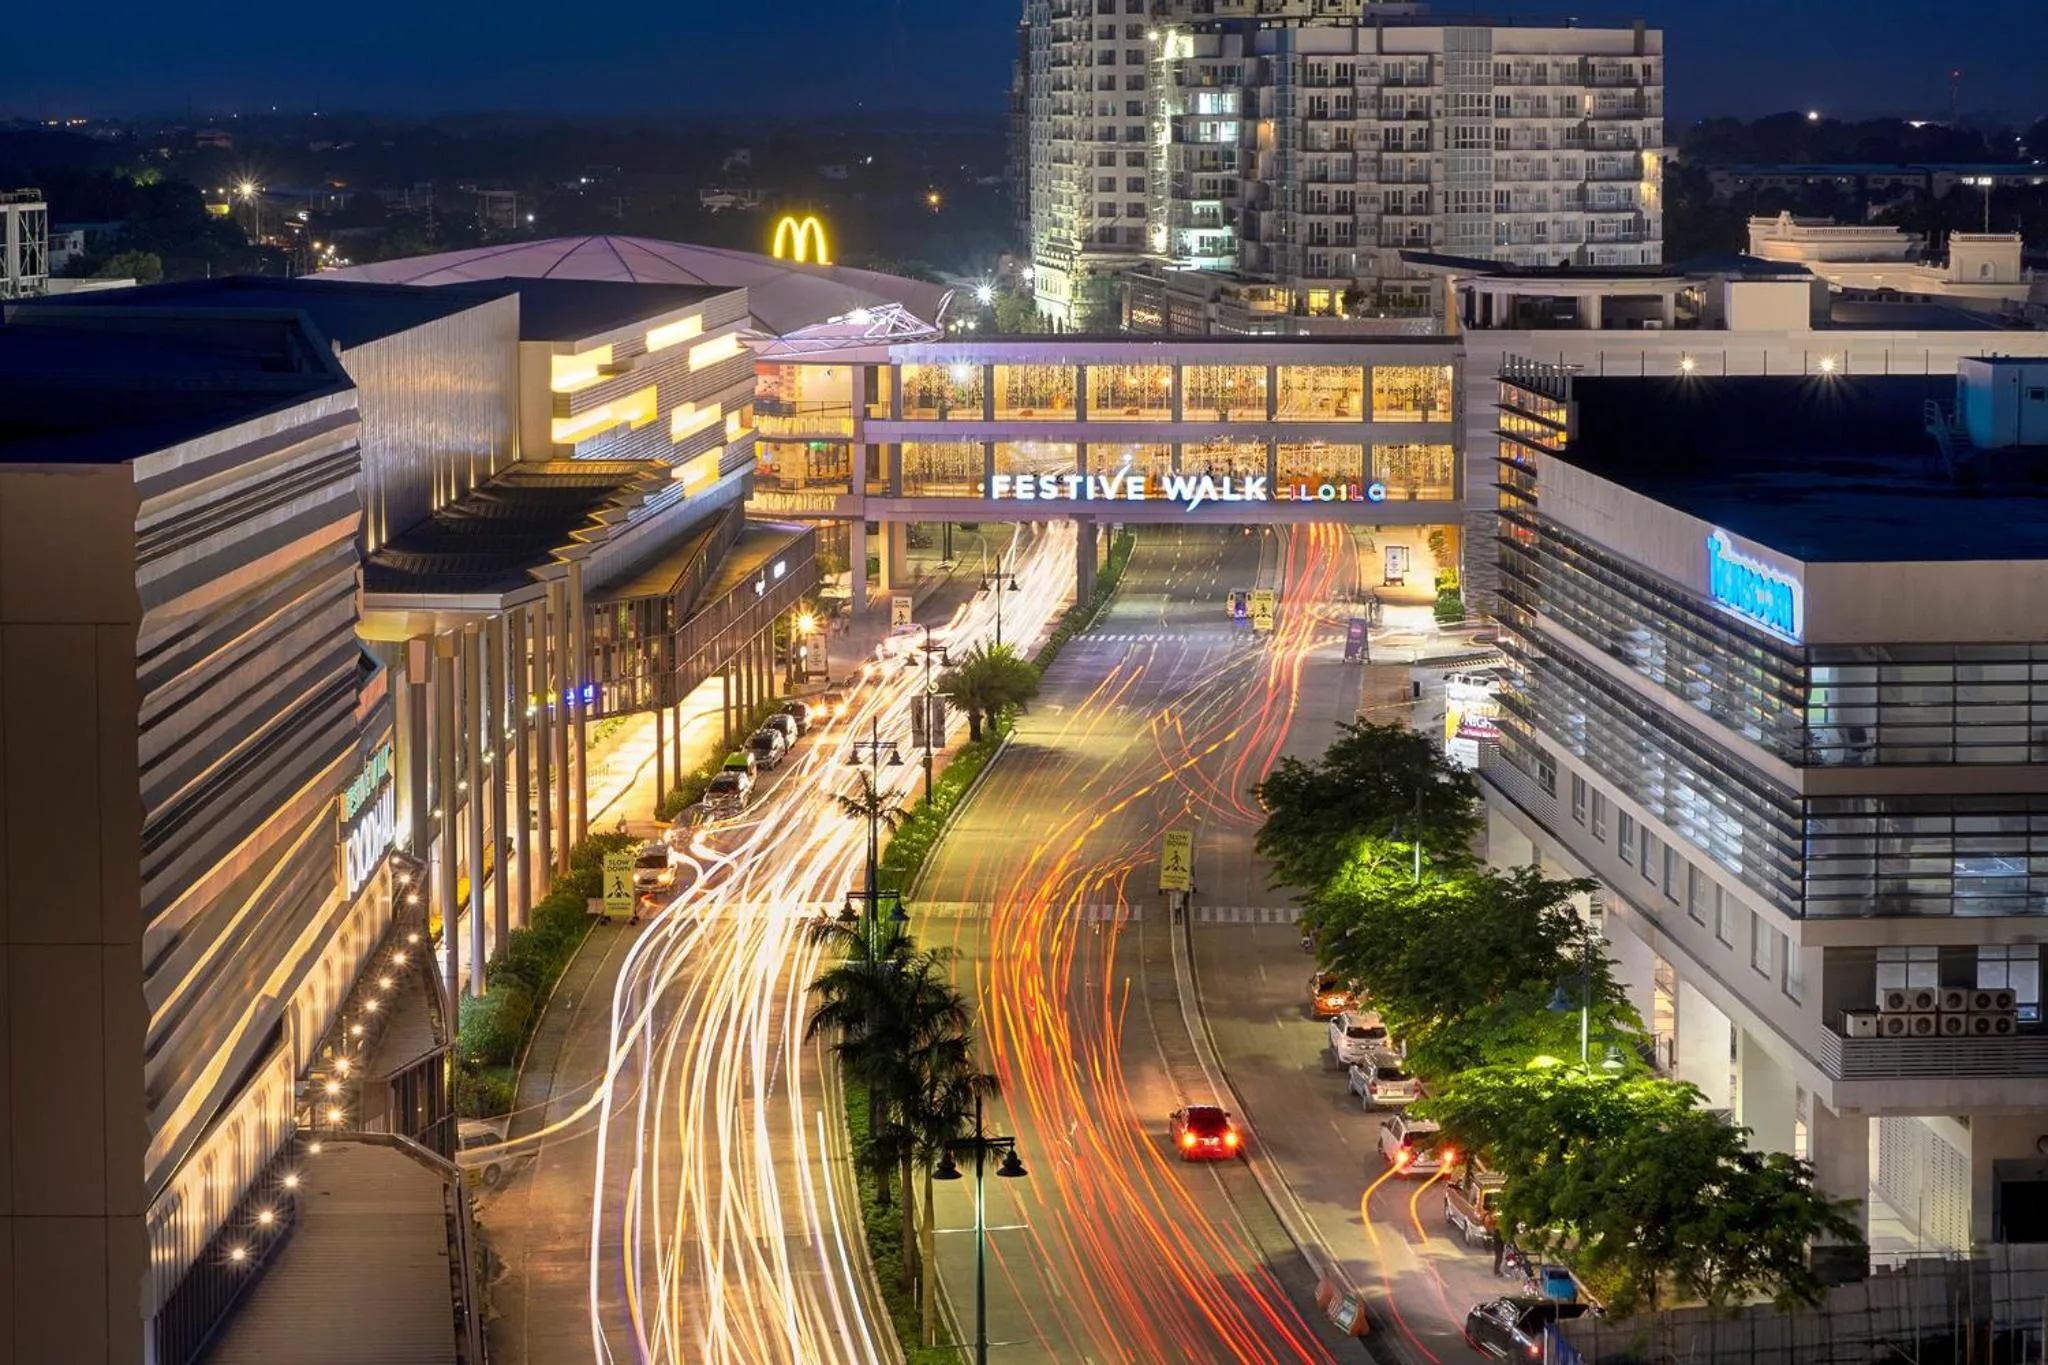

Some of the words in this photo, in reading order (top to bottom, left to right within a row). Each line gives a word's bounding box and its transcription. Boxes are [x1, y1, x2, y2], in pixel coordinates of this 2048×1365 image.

[991, 464, 1146, 500] FESTIVE
[1163, 475, 1268, 512] WALK
[1289, 482, 1388, 502] ILOILO
